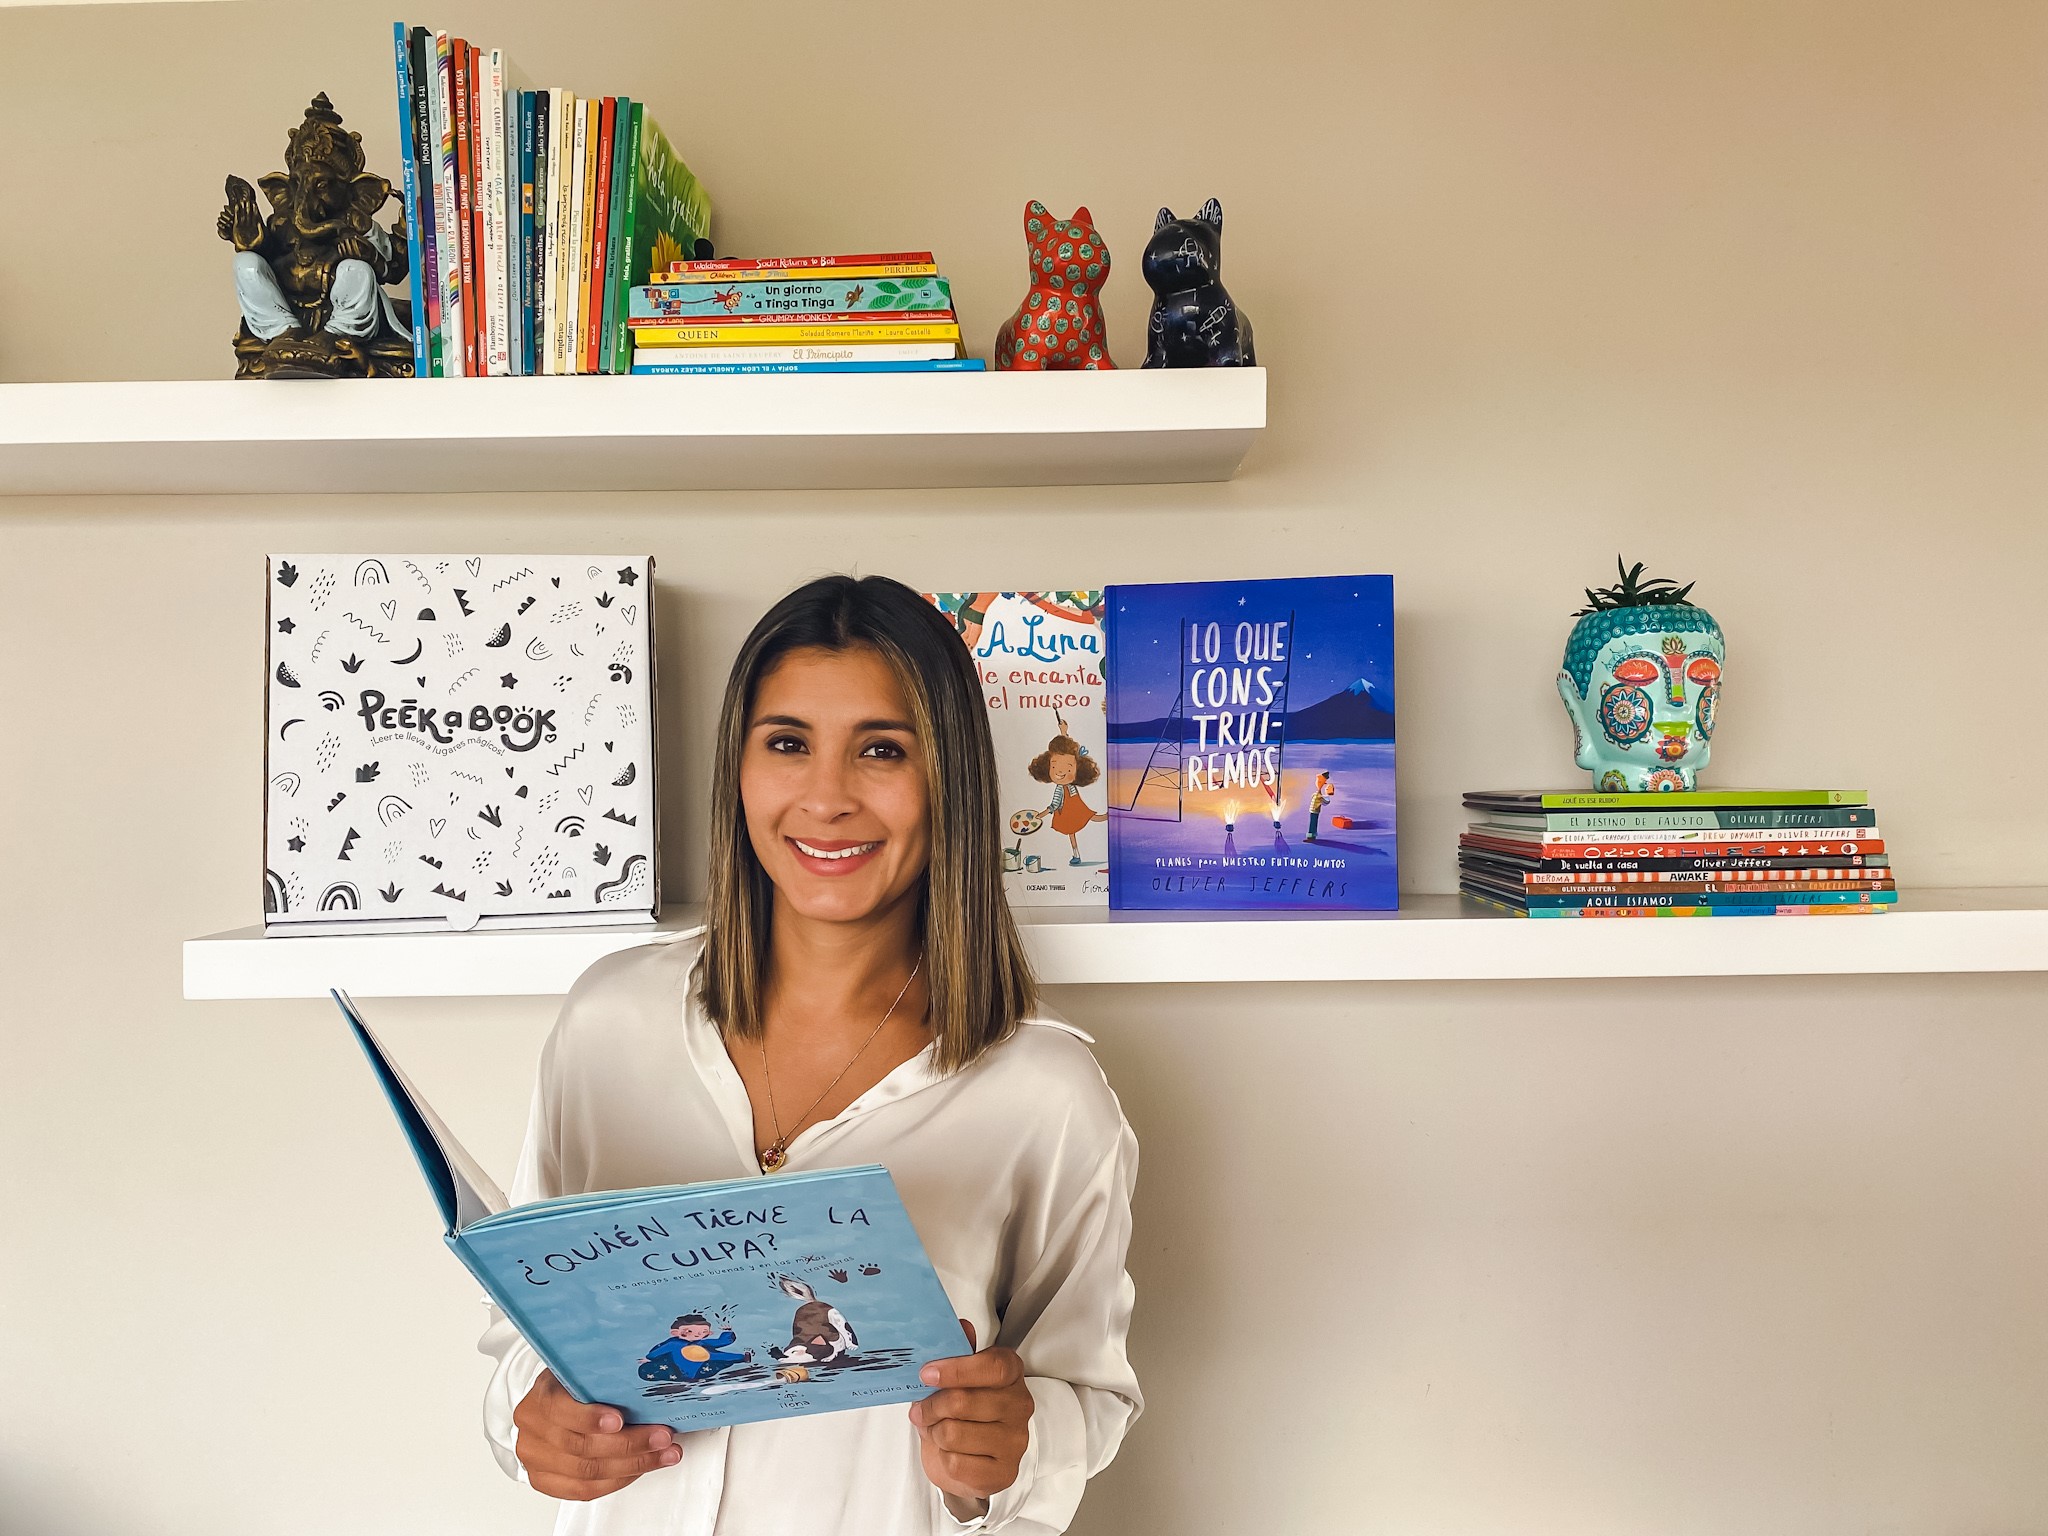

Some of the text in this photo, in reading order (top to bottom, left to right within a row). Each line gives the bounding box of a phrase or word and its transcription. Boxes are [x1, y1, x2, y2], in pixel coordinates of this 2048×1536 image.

[456, 69, 466, 140] LEJOS, LEJOS DE CASA
[420, 119, 428, 141] WORLD
[422, 143, 430, 165] NOW!
[476, 168, 481, 178] no
[1196, 199, 1221, 224] STARS
[462, 220, 470, 258] WOODWORTH
[624, 237, 632, 263] gratitud
[811, 257, 819, 265] to
[820, 256, 836, 267] Bali
[463, 262, 471, 283] RACHEL
[884, 266, 928, 274] PERIPLUS
[642, 286, 680, 300] Tinga
[765, 284, 822, 298] Un giorno
[650, 300, 682, 310] Tinga
[754, 298, 835, 310] a Tinga Tinga
[639, 318, 657, 326] Lang
[758, 313, 833, 324] GRUMPY MONKEY
[677, 330, 719, 340] QUEEN
[800, 328, 850, 337] Soledad Romero
[885, 328, 904, 336] Laura
[792, 348, 854, 362] El Principito
[708, 366, 735, 374] ÁNGELA
[976, 614, 1100, 663] A Luna
[1190, 622, 1288, 664] LO QUE
[978, 661, 1102, 686] le encanta
[1190, 666, 1284, 708] CONS-
[988, 686, 1091, 710] el museo
[468, 704, 557, 752] BOOK
[1192, 710, 1283, 753] TRUI-
[370, 732, 392, 747] ¡Leer
[394, 732, 404, 740] te
[406, 732, 426, 746] lleva
[432, 740, 466, 756] lugares
[467, 736, 506, 756] mágicos!
[1188, 746, 1278, 792] REMOS
[1562, 796, 1577, 804] ¿QUÉ
[1570, 816, 1704, 827] EL DESTINO DE FAUSTO
[1730, 814, 1822, 824] OLIVER JEFFERS
[1703, 831, 1764, 840] DREW DAYWALT
[1777, 830, 1851, 839] OLIVER JEFFERS
[1155, 857, 1346, 869] PLANES para NUESTRO FUTURO JUNTOS
[1560, 860, 1639, 870] De vuelta a casa
[1694, 858, 1772, 868] Oliver Jeffers
[1670, 872, 1710, 882] AWAKE
[1152, 876, 1348, 898] OLIVER JEFFERS
[1704, 884, 1718, 893] EL
[1586, 895, 1674, 908] AQUÍ ESTAMOS
[1738, 906, 1793, 915] Anthony Browne
[516, 1206, 871, 1286] ¿QUIÉN TIENE LA
[641, 1232, 778, 1272] CULPA?
[804, 1256, 855, 1273] travesuras
[607, 1258, 792, 1292] Los amigos en las buenas y en las
[851, 1386, 902, 1398] Alejandra
[668, 1410, 726, 1424] Laura Daza
